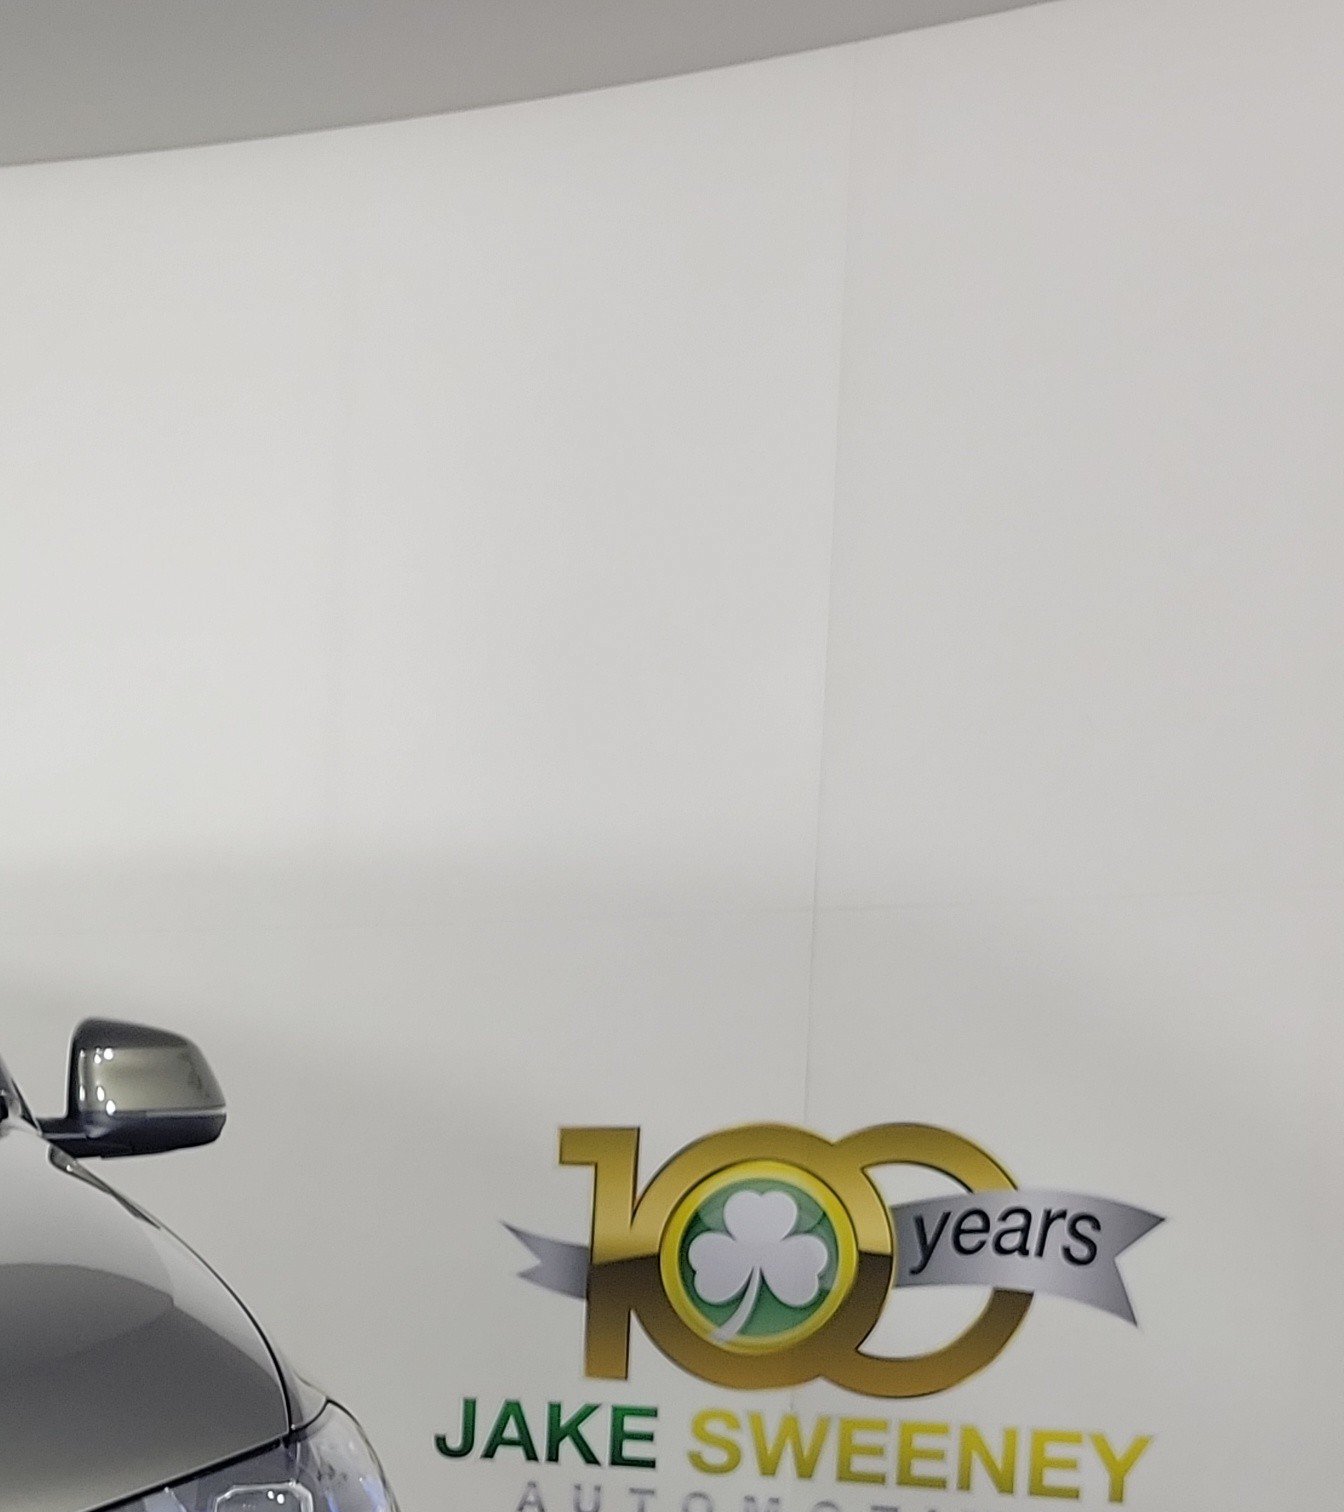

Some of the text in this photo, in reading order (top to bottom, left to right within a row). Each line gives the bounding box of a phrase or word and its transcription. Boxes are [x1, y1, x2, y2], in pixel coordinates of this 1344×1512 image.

[558, 1121, 1102, 1399] 100 years
[434, 1398, 1157, 1503] JAKE SWEENEY
